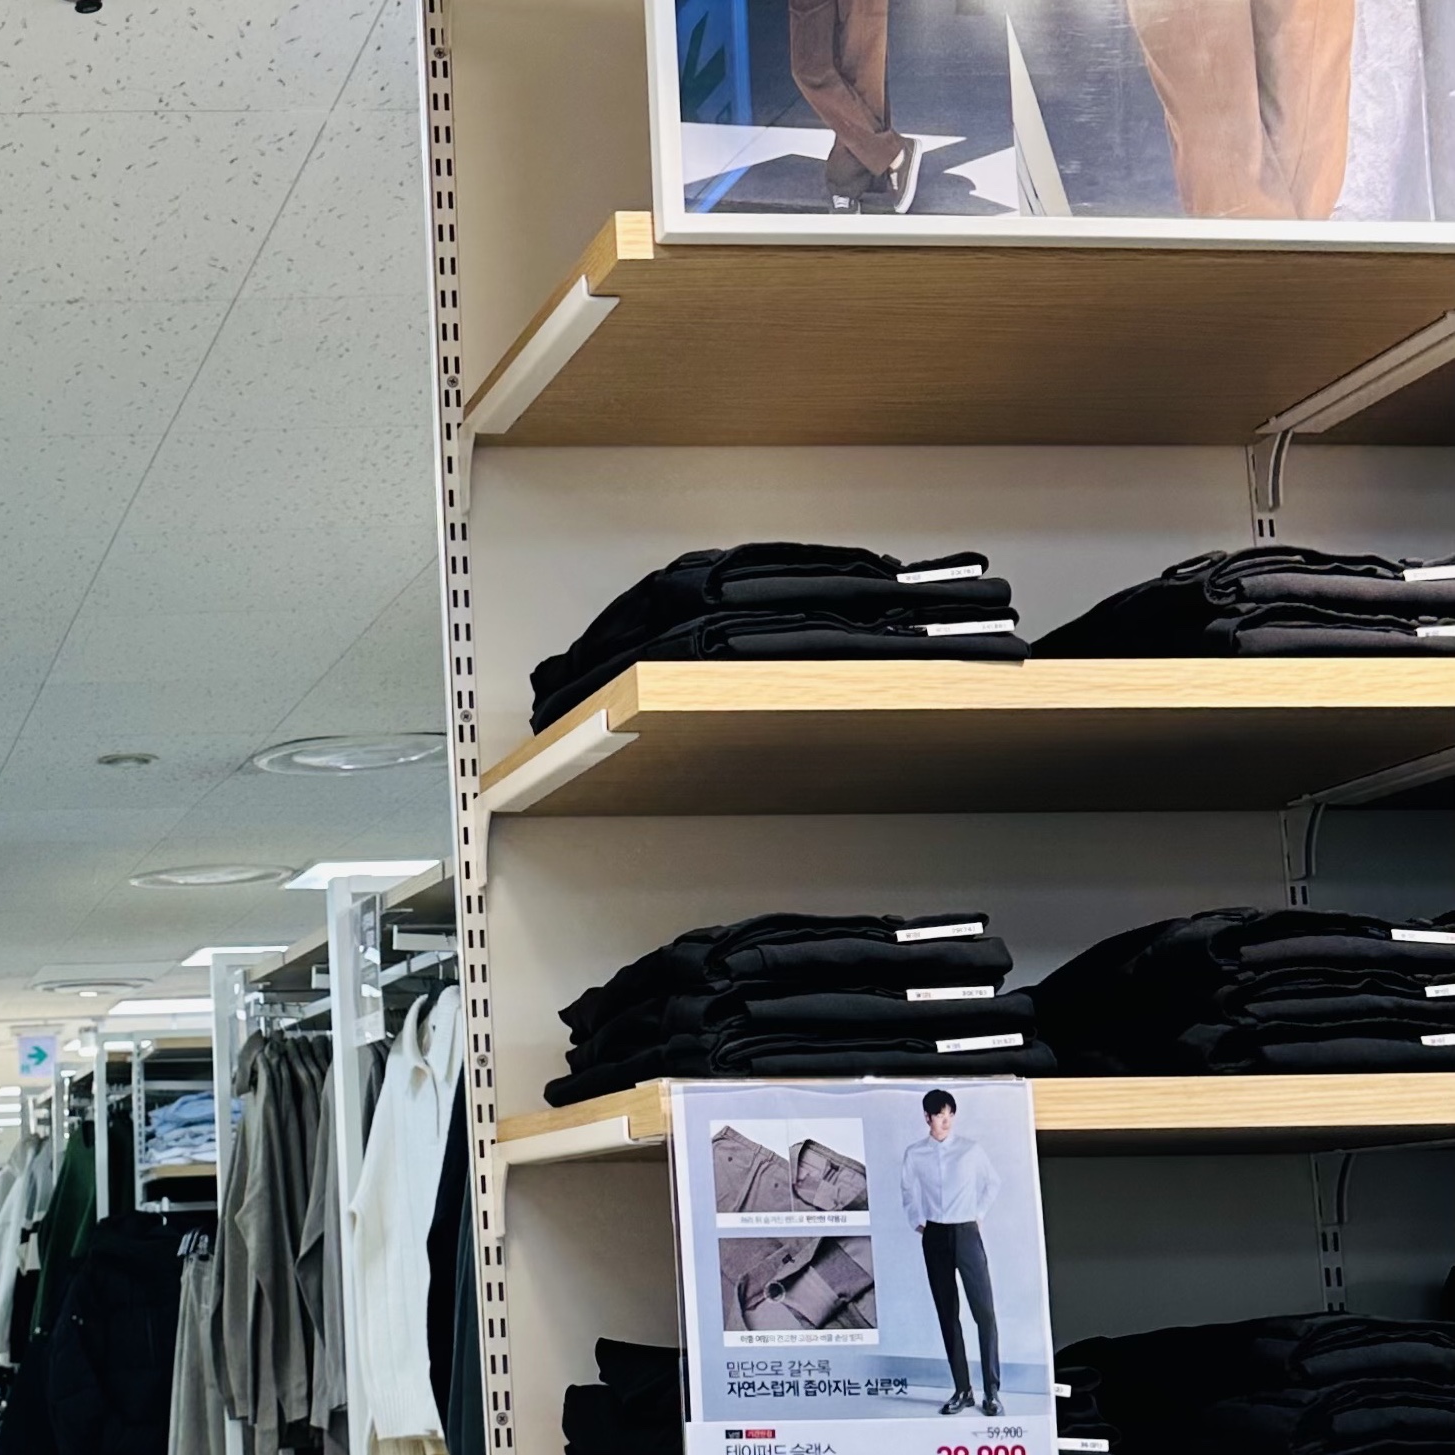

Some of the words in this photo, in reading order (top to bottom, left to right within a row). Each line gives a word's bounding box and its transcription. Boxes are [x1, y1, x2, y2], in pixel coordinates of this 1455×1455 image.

[726, 1361, 784, 1379] 밑단으로
[787, 1360, 831, 1378] 갈수록
[727, 1379, 800, 1398] 자연스럽게
[803, 1379, 861, 1397] 좁아지는
[864, 1377, 908, 1396] 실루엣
[987, 1426, 1023, 1440] 59,900
